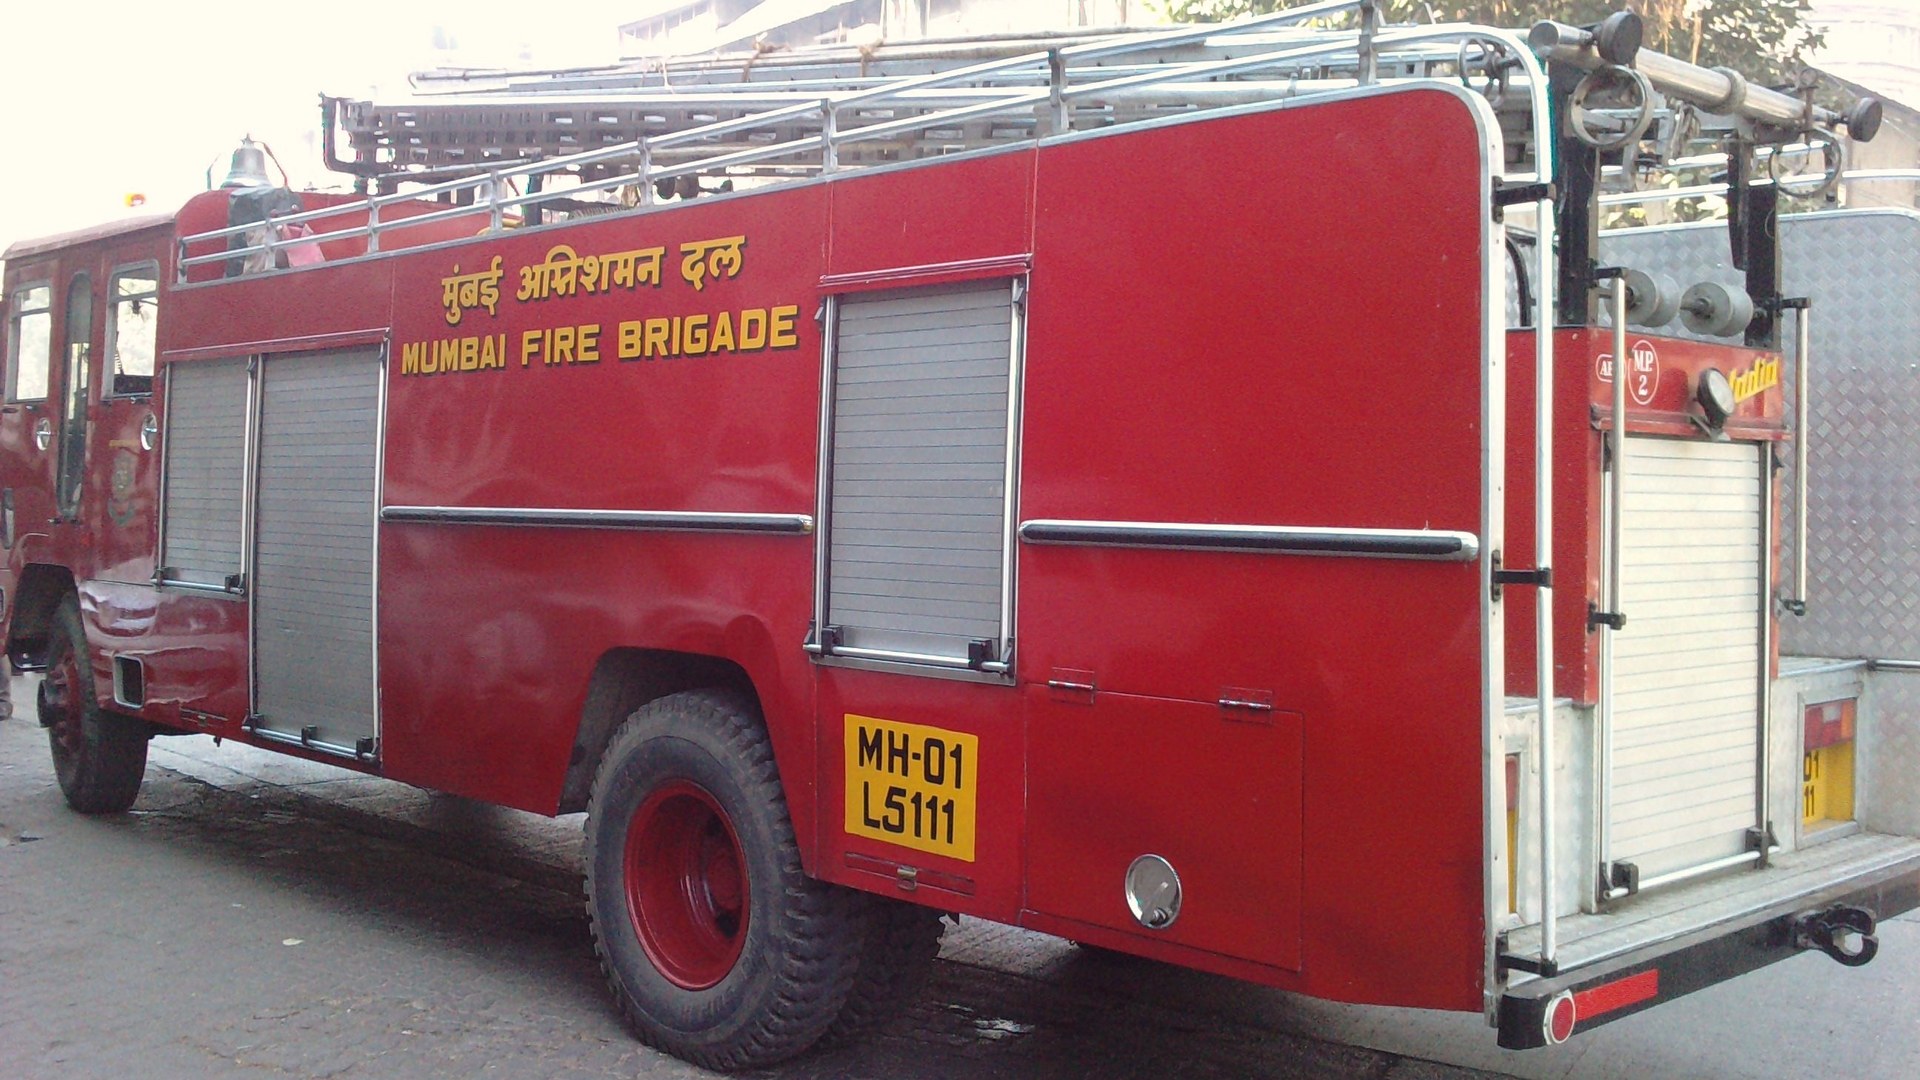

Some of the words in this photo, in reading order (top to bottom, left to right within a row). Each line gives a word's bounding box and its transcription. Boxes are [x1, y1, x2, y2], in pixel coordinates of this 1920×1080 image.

[441, 255, 503, 324] मुंबई
[680, 235, 746, 291] दल
[401, 334, 506, 376] MUMBAI
[521, 324, 601, 366] FIRE
[618, 305, 799, 360] BRIGADE
[1632, 349, 1654, 372] MP
[1638, 374, 1648, 396] 2
[858, 726, 963, 790] MH-01
[862, 780, 955, 845] L5111
